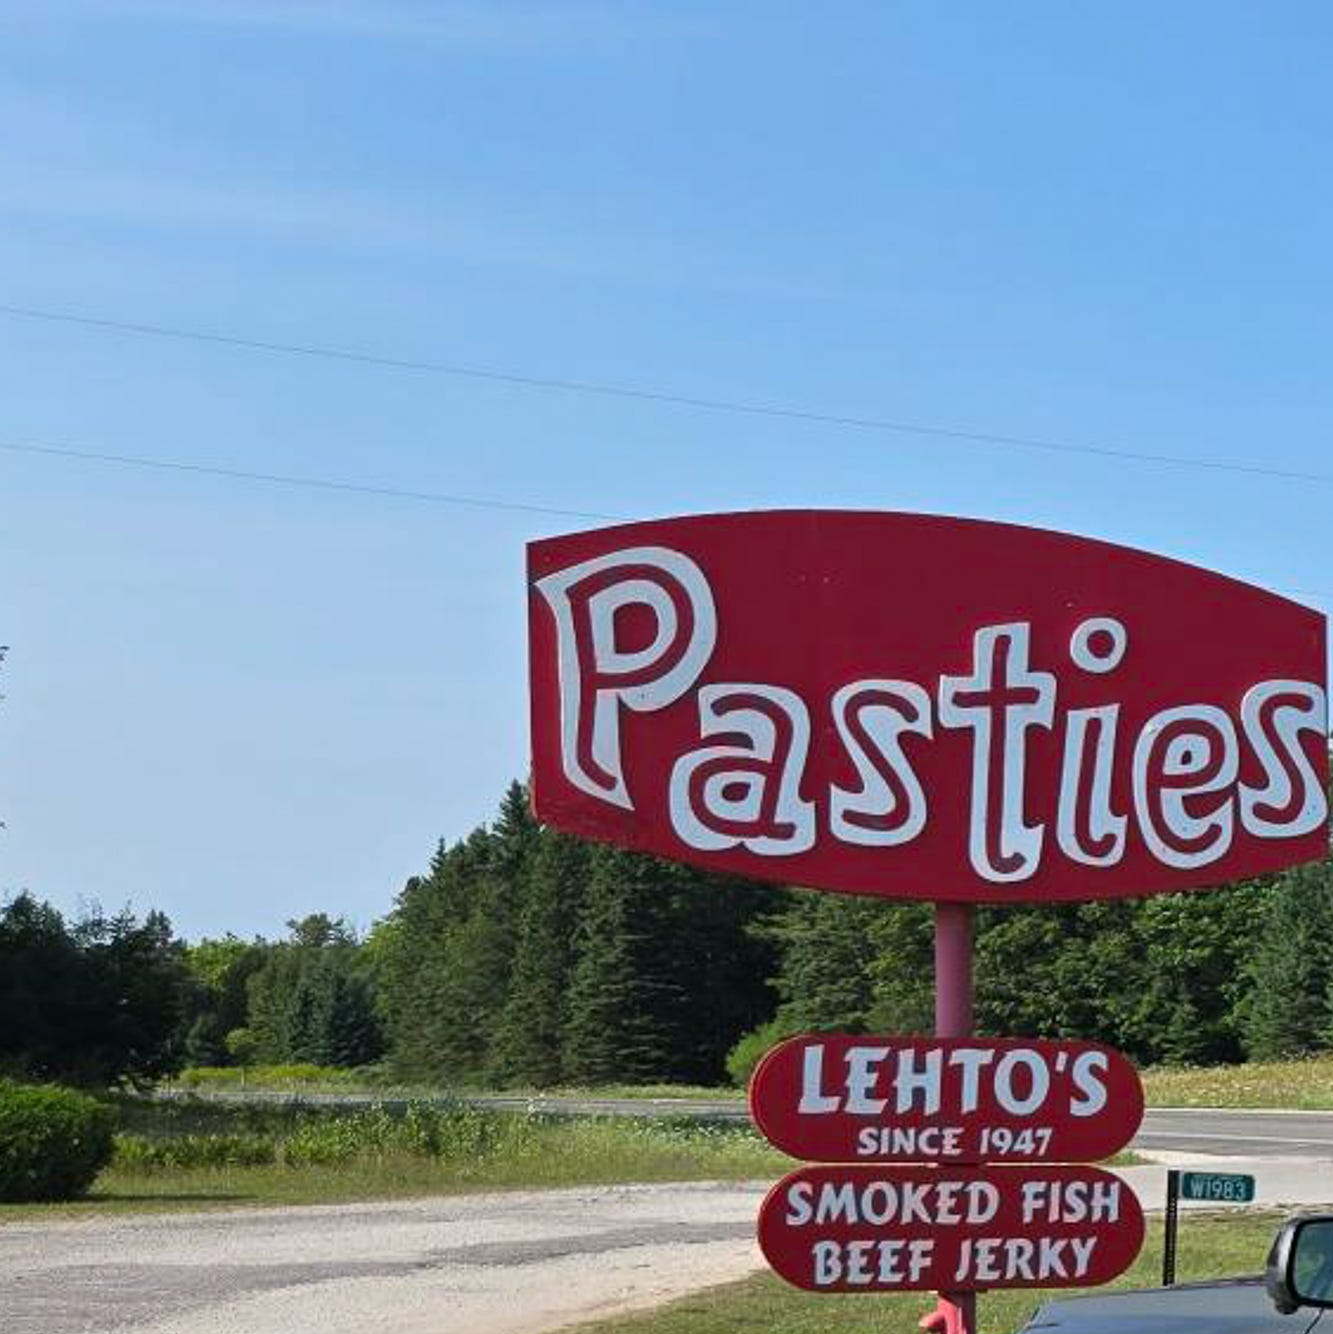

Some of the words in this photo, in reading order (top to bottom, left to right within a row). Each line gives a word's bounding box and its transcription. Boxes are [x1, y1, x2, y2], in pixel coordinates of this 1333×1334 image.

[536, 547, 1327, 883] Pasties
[798, 1044, 1108, 1117] LEHTO'S
[857, 1127, 965, 1156] SINCE
[979, 1127, 1053, 1156] 1947
[785, 1181, 1001, 1225] SMOKED
[1022, 1181, 1121, 1224] FISH
[1190, 1180, 1247, 1200] W1983
[812, 1239, 936, 1285] BEEF
[955, 1236, 1098, 1282] JERKY
